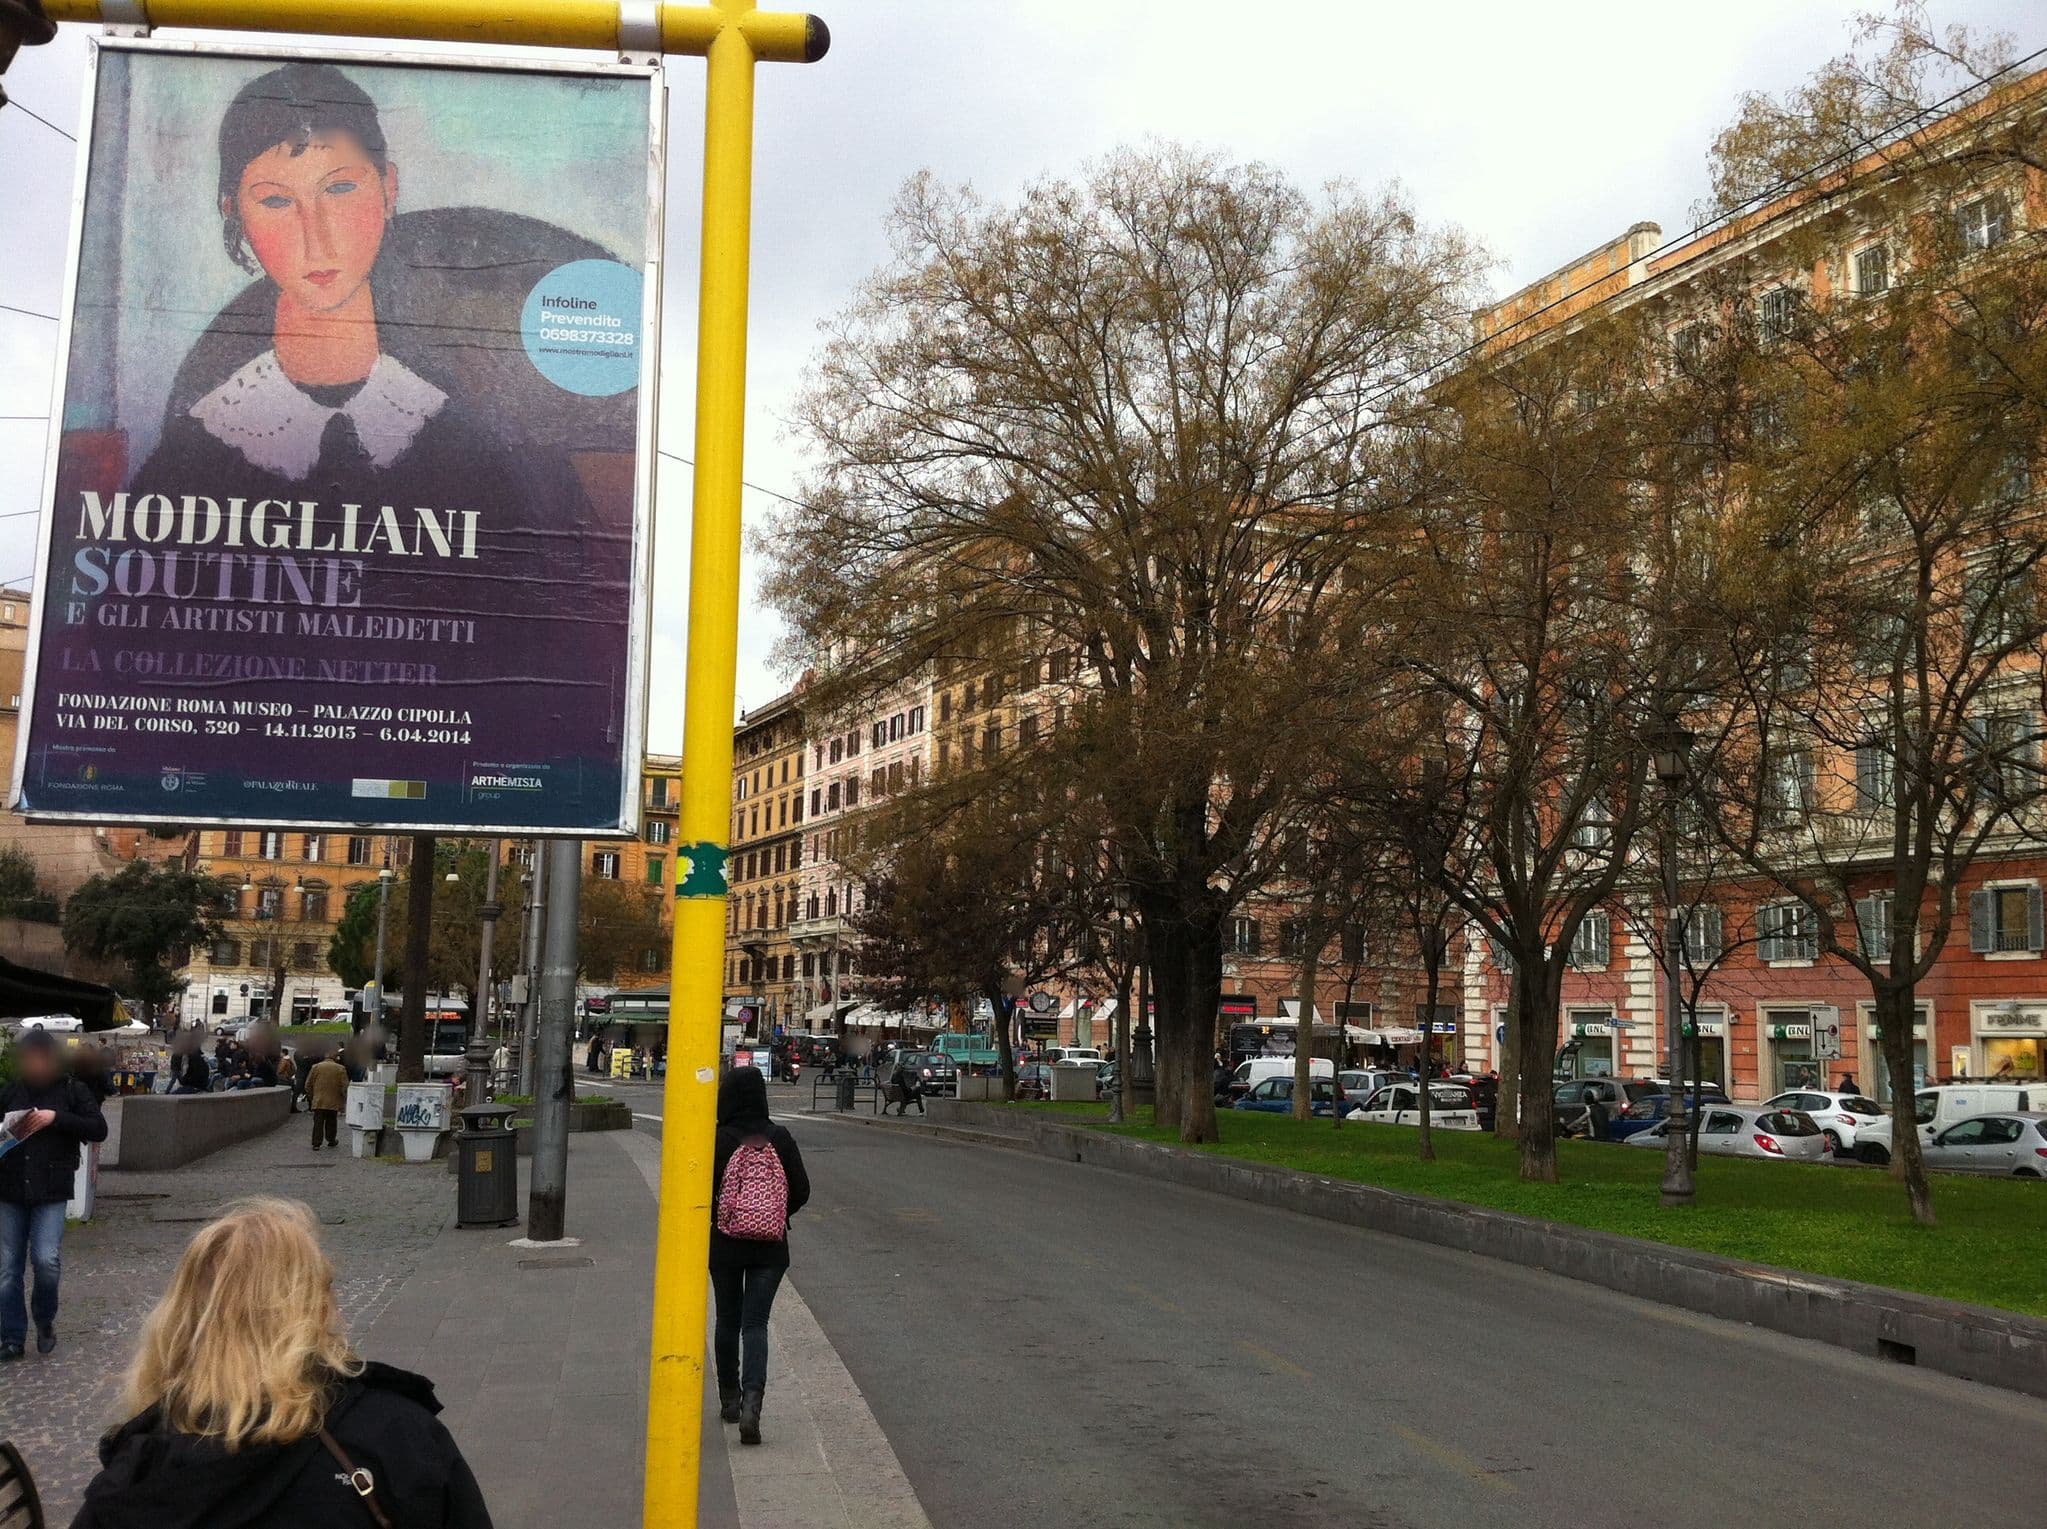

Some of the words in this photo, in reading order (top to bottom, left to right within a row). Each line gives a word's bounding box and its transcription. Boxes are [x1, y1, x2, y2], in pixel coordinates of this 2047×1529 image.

[542, 295, 598, 310] Infoline
[541, 311, 621, 327] Prevendita
[540, 328, 634, 345] 0698373328
[75, 491, 481, 559] MODIGLIANI
[71, 547, 363, 607] SOUTINE
[64, 601, 86, 625] E
[98, 604, 148, 628] GLI
[161, 606, 285, 634] ARTISTI
[299, 612, 477, 644] MALEDETTI
[61, 647, 101, 673] LA
[115, 650, 305, 681] COLLEZIONE
[318, 658, 438, 686] NETTER
[57, 692, 172, 713] FONDAZIONE
[177, 697, 226, 715] ROMA
[232, 700, 293, 718] MUSEO
[313, 705, 393, 722] PALAZZO
[397, 708, 472, 725] CIPOLLA
[56, 713, 87, 730] VIA
[93, 715, 128, 731] DEL
[134, 717, 198, 734] CORSO,
[205, 720, 240, 736] 320
[264, 722, 356, 740] 14.11.2013
[379, 727, 472, 745] 6.04.2014
[471, 775, 543, 788] ARTHEMISIA
[1586, 1025, 1606, 1033] BNL
